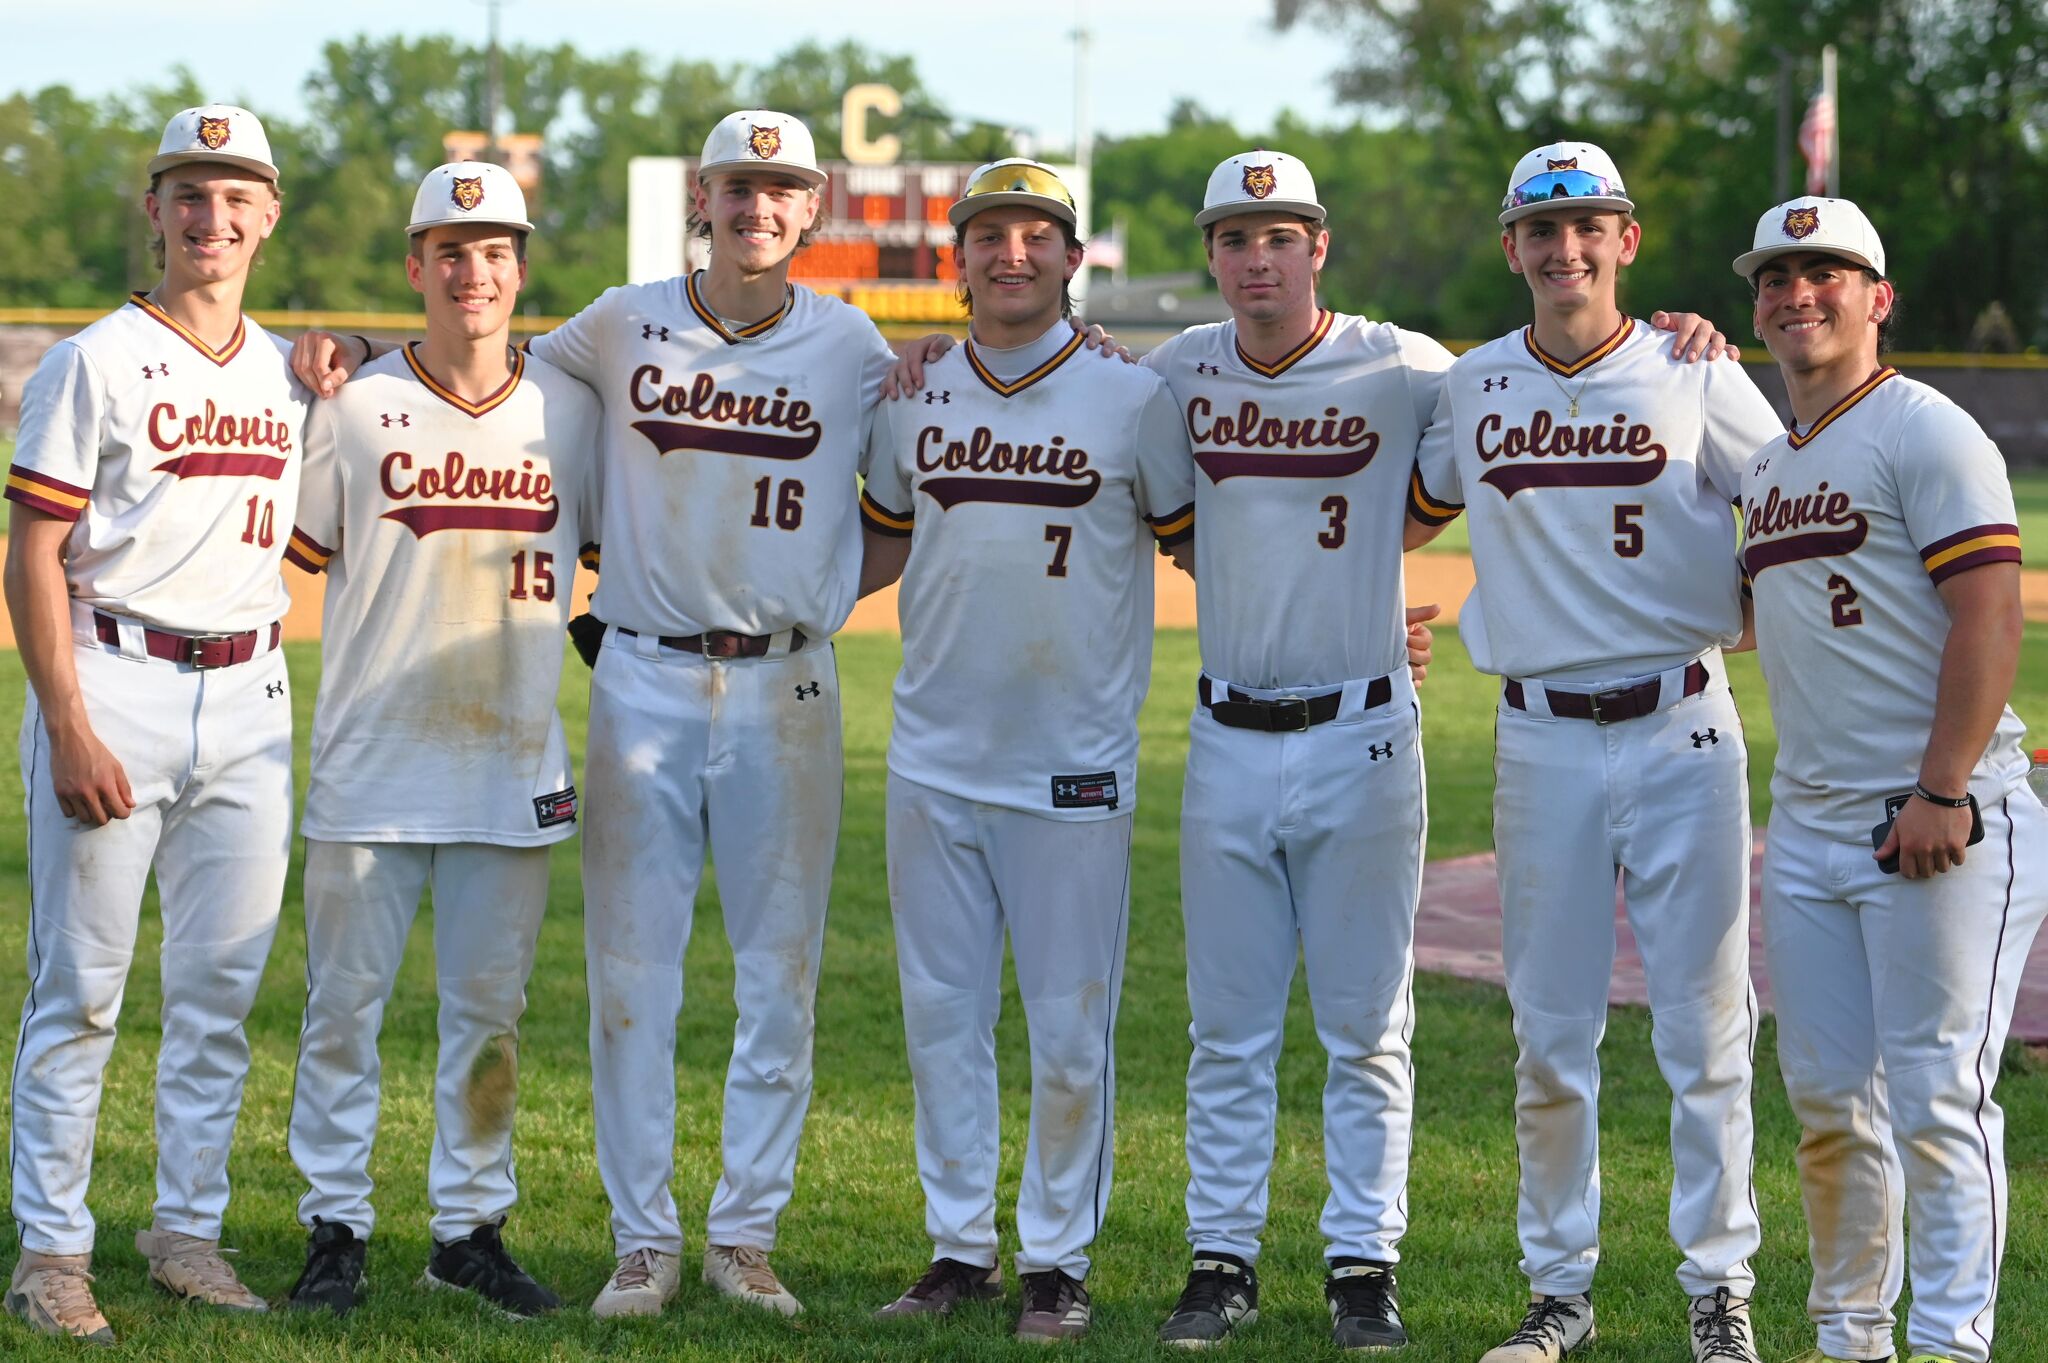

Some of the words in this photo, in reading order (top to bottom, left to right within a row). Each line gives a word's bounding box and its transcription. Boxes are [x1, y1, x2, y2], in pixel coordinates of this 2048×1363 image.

[841, 83, 901, 165] C
[147, 397, 292, 453] Colonie
[630, 364, 815, 431] Colonie
[1187, 396, 1372, 449] Colonie
[916, 426, 1095, 481] Colonie
[1476, 410, 1658, 463] Colonie
[380, 451, 555, 504] Colonie
[750, 475, 805, 531] 16
[240, 494, 275, 549] 10
[1317, 495, 1349, 550] 3
[1613, 504, 1644, 558] 5
[510, 550, 555, 602] 15
[1044, 524, 1073, 578] 7
[1827, 573, 1863, 628] 2
